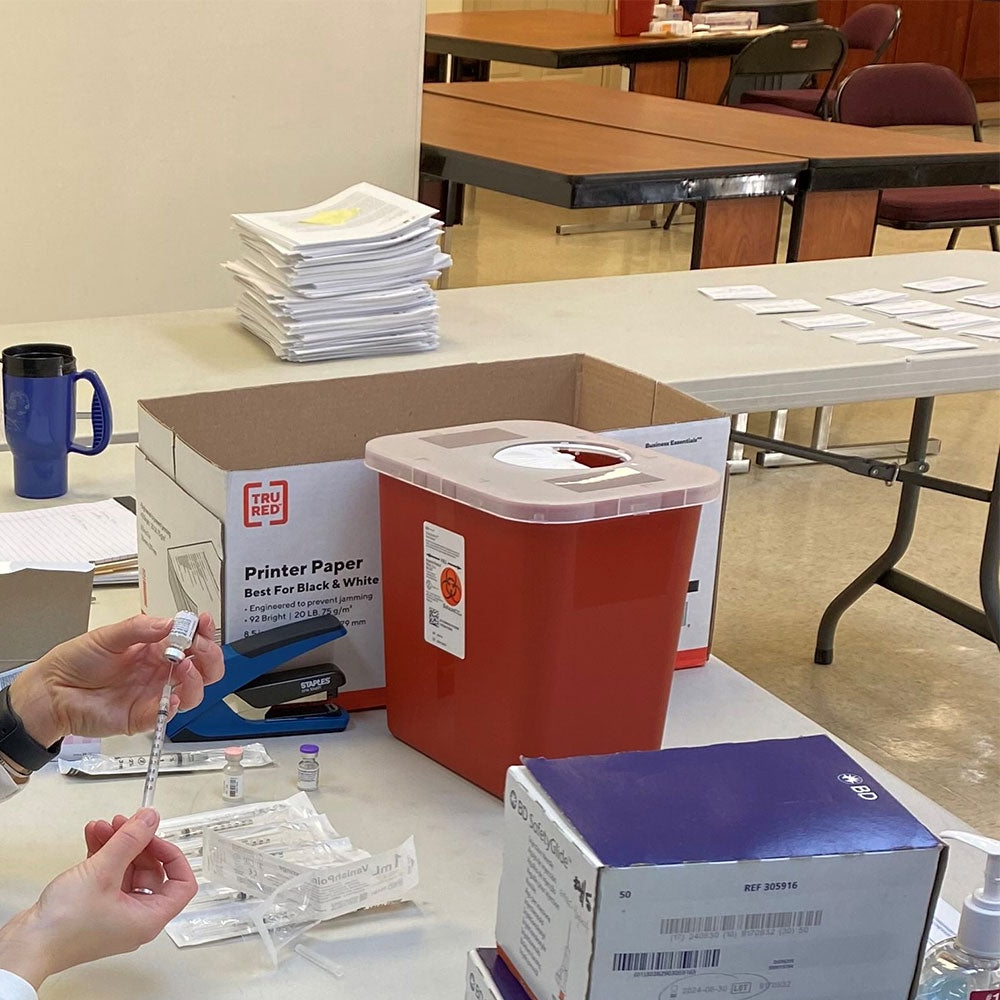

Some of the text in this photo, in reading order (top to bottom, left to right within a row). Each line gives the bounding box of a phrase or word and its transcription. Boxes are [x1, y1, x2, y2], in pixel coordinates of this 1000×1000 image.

[252, 492, 280, 504] TRU
[245, 559, 363, 581] Printer Paper
[244, 576, 379, 598] Best For Black & White
[250, 601, 295, 614] Engineered
[307, 597, 337, 611] prevent
[338, 594, 373, 604] jamming
[262, 613, 286, 624] Bright
[300, 677, 330, 689] STAPLES
[850, 786, 878, 800] BD
[517, 800, 528, 821] BD
[744, 881, 798, 892] REF 305916
